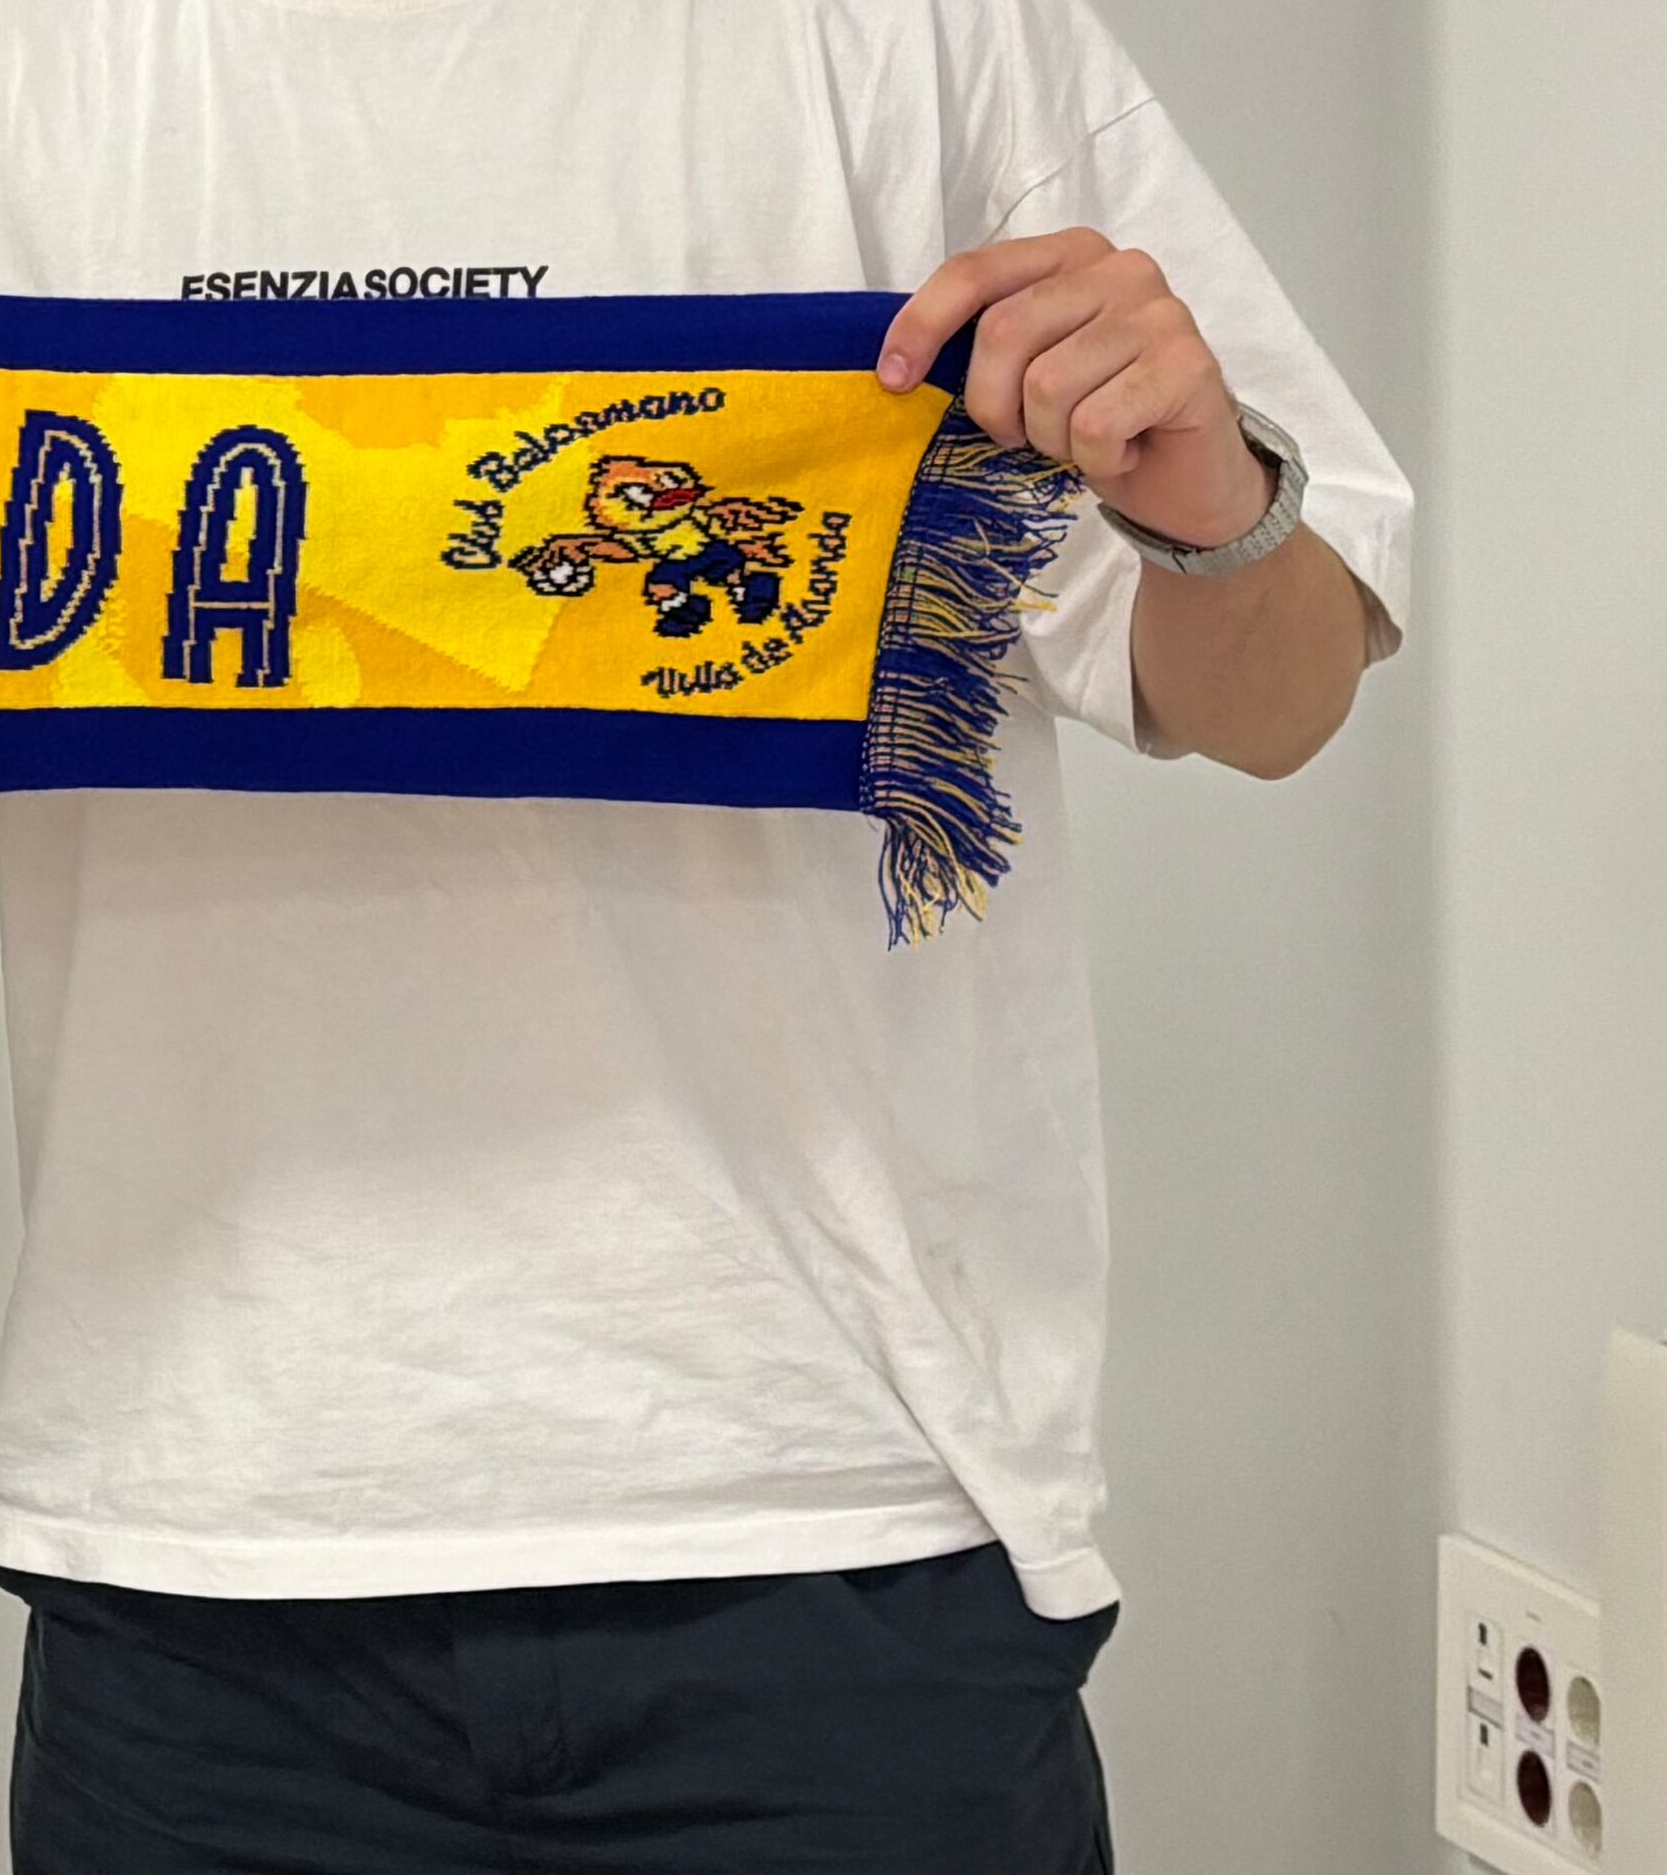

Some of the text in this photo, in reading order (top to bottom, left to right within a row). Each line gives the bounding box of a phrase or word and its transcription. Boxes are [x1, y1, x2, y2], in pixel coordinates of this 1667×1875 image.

[441, 386, 727, 569] Club Balonmano
[640, 659, 744, 699] Villa
[740, 637, 793, 675] de
